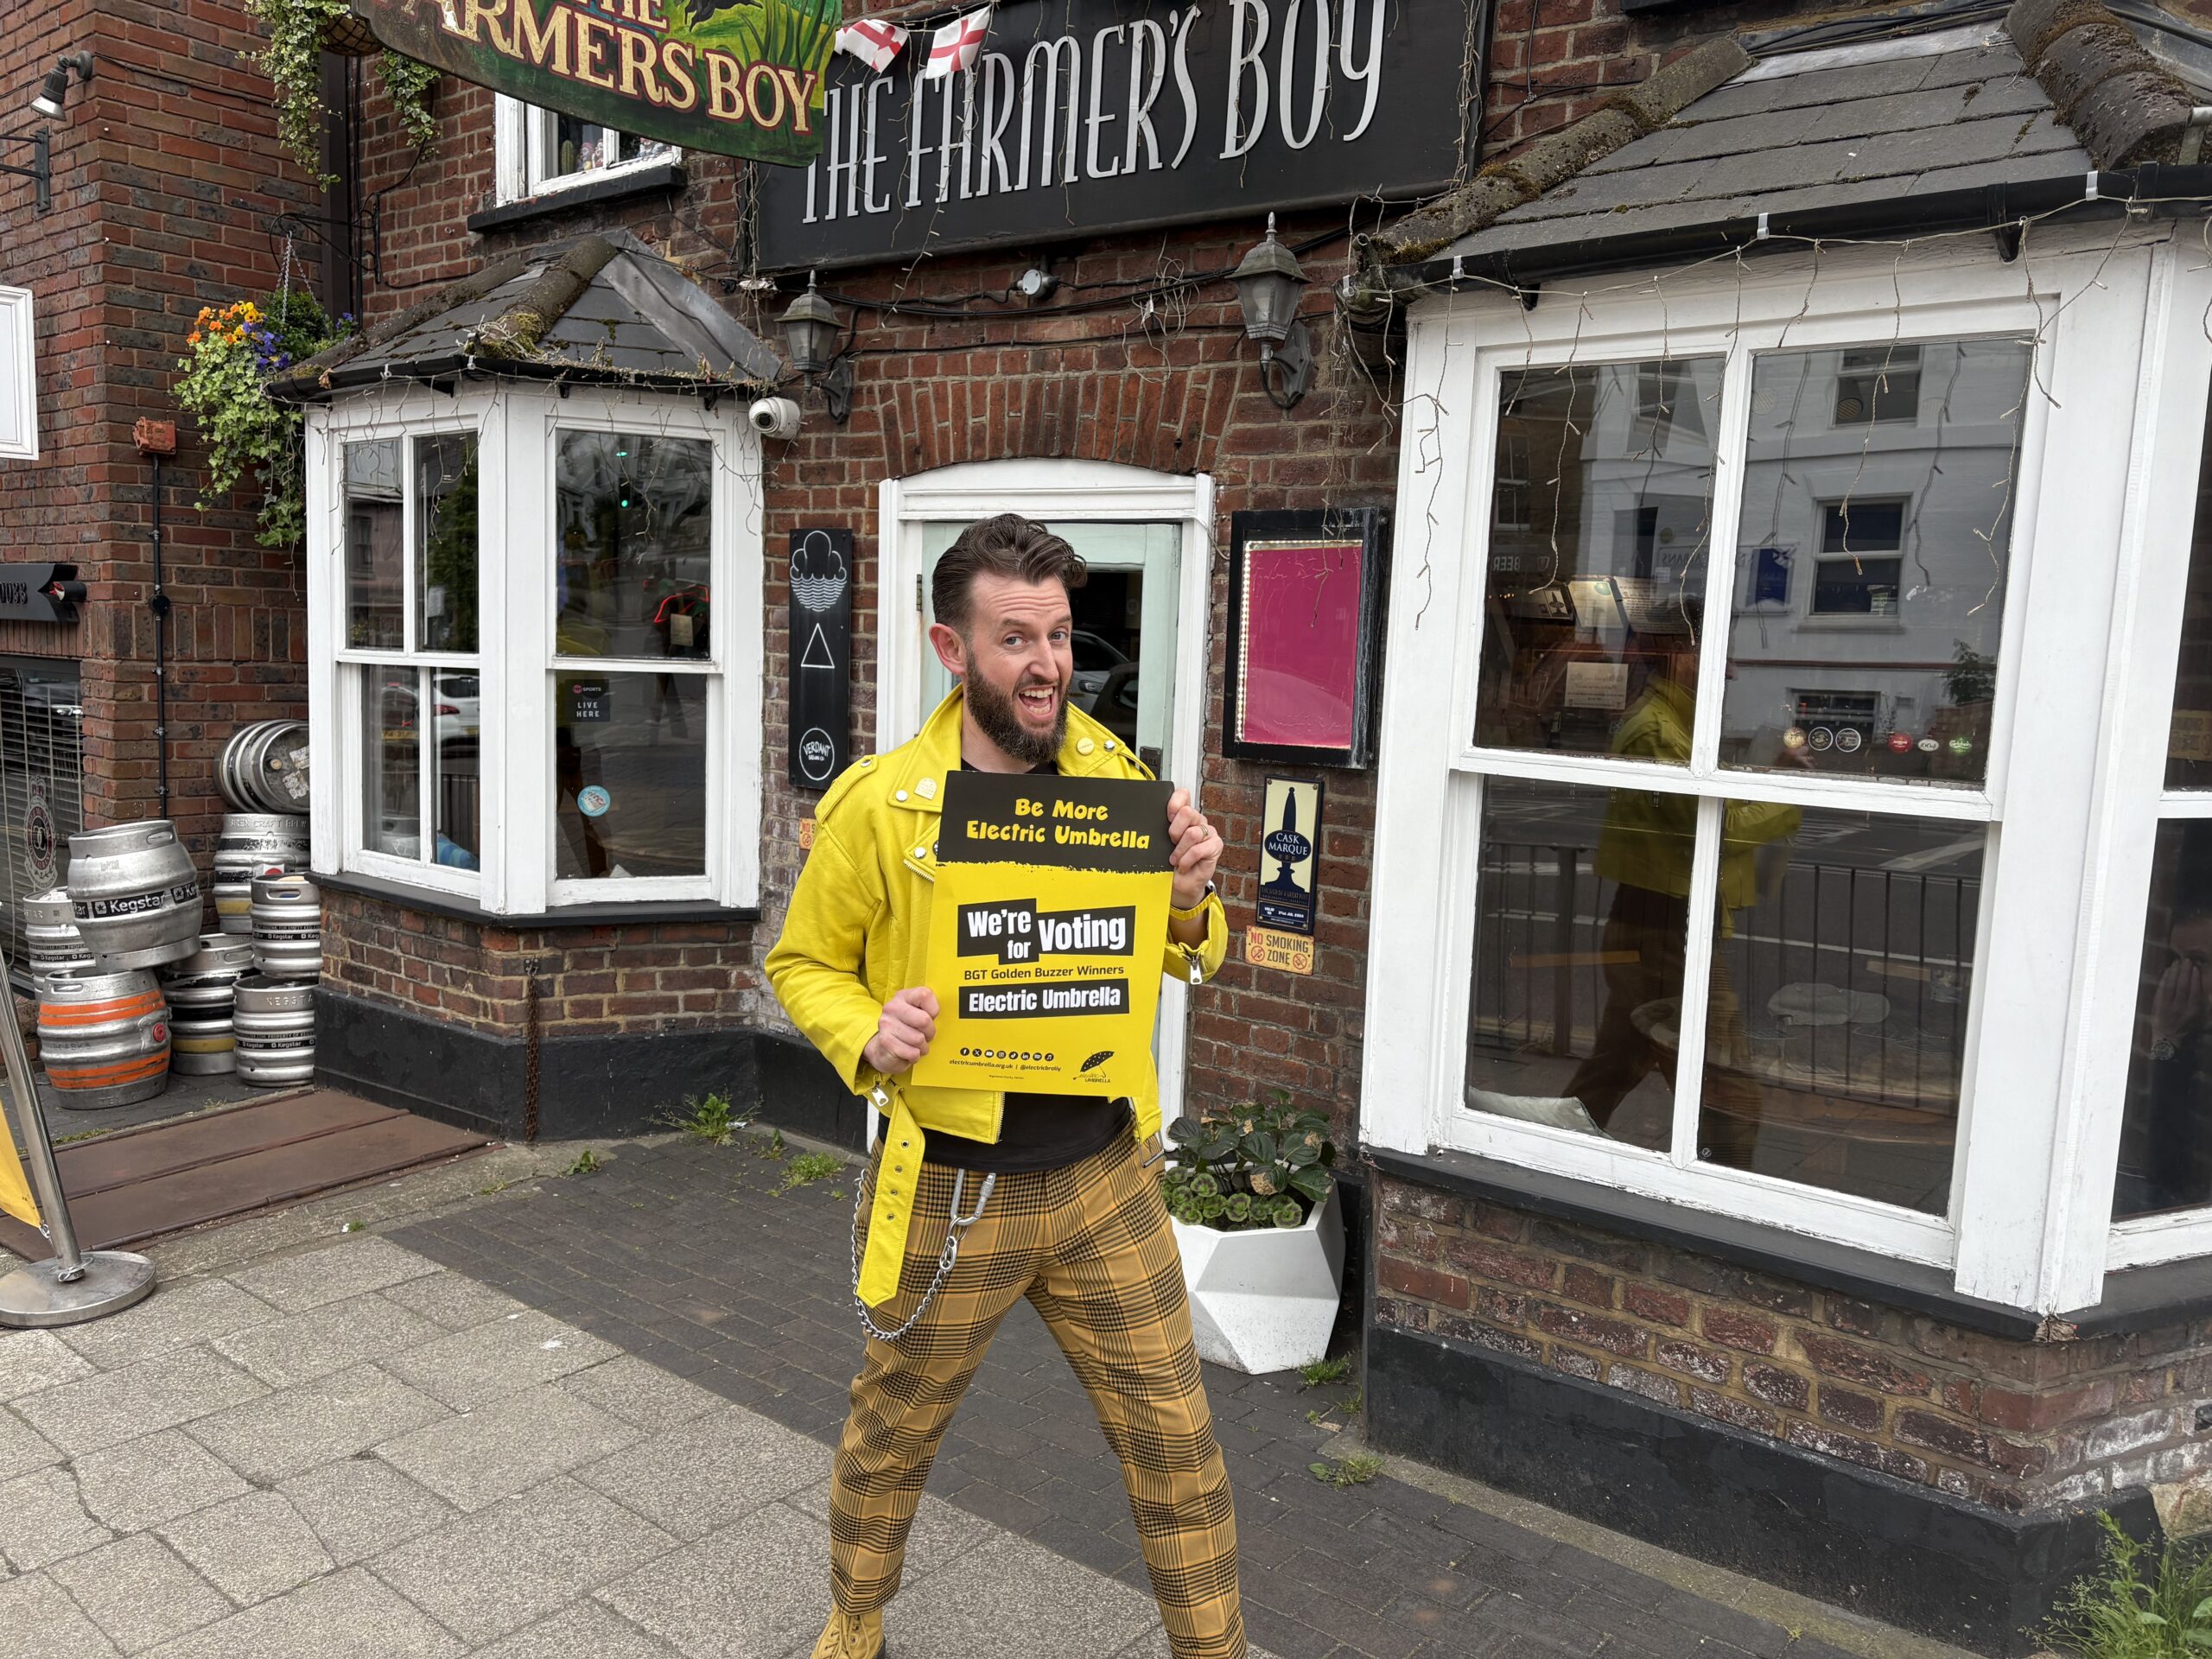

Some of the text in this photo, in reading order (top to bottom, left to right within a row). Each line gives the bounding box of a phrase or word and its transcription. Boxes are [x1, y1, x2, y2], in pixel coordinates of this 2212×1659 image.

[705, 52, 817, 132] BOY
[802, 0, 1386, 224] THE FARMER'S BOY
[803, 741, 831, 758] VERDANT
[1015, 798, 1109, 821] Be More
[230, 818, 250, 827] SIREN
[253, 819, 283, 828] CRAFT
[802, 822, 810, 832] NO
[966, 820, 1150, 849] Electric Umbrella
[1276, 832, 1300, 845] CASK
[1268, 841, 1309, 856] MARQUE
[109, 893, 165, 914] Kegstar
[967, 909, 1032, 938] We're
[1038, 914, 1126, 951] Voting
[1007, 940, 1032, 959] for
[1250, 931, 1309, 953] NO SMOKING
[1267, 950, 1291, 965] ZONE
[963, 964, 1125, 981] BGT Golden Buzzer Winners
[266, 995, 313, 1006] KEGSTA
[969, 987, 1122, 1013] Electric Umbrella
[949, 1059, 1062, 1072] electricumbrella.org.uk @electricbrolly
